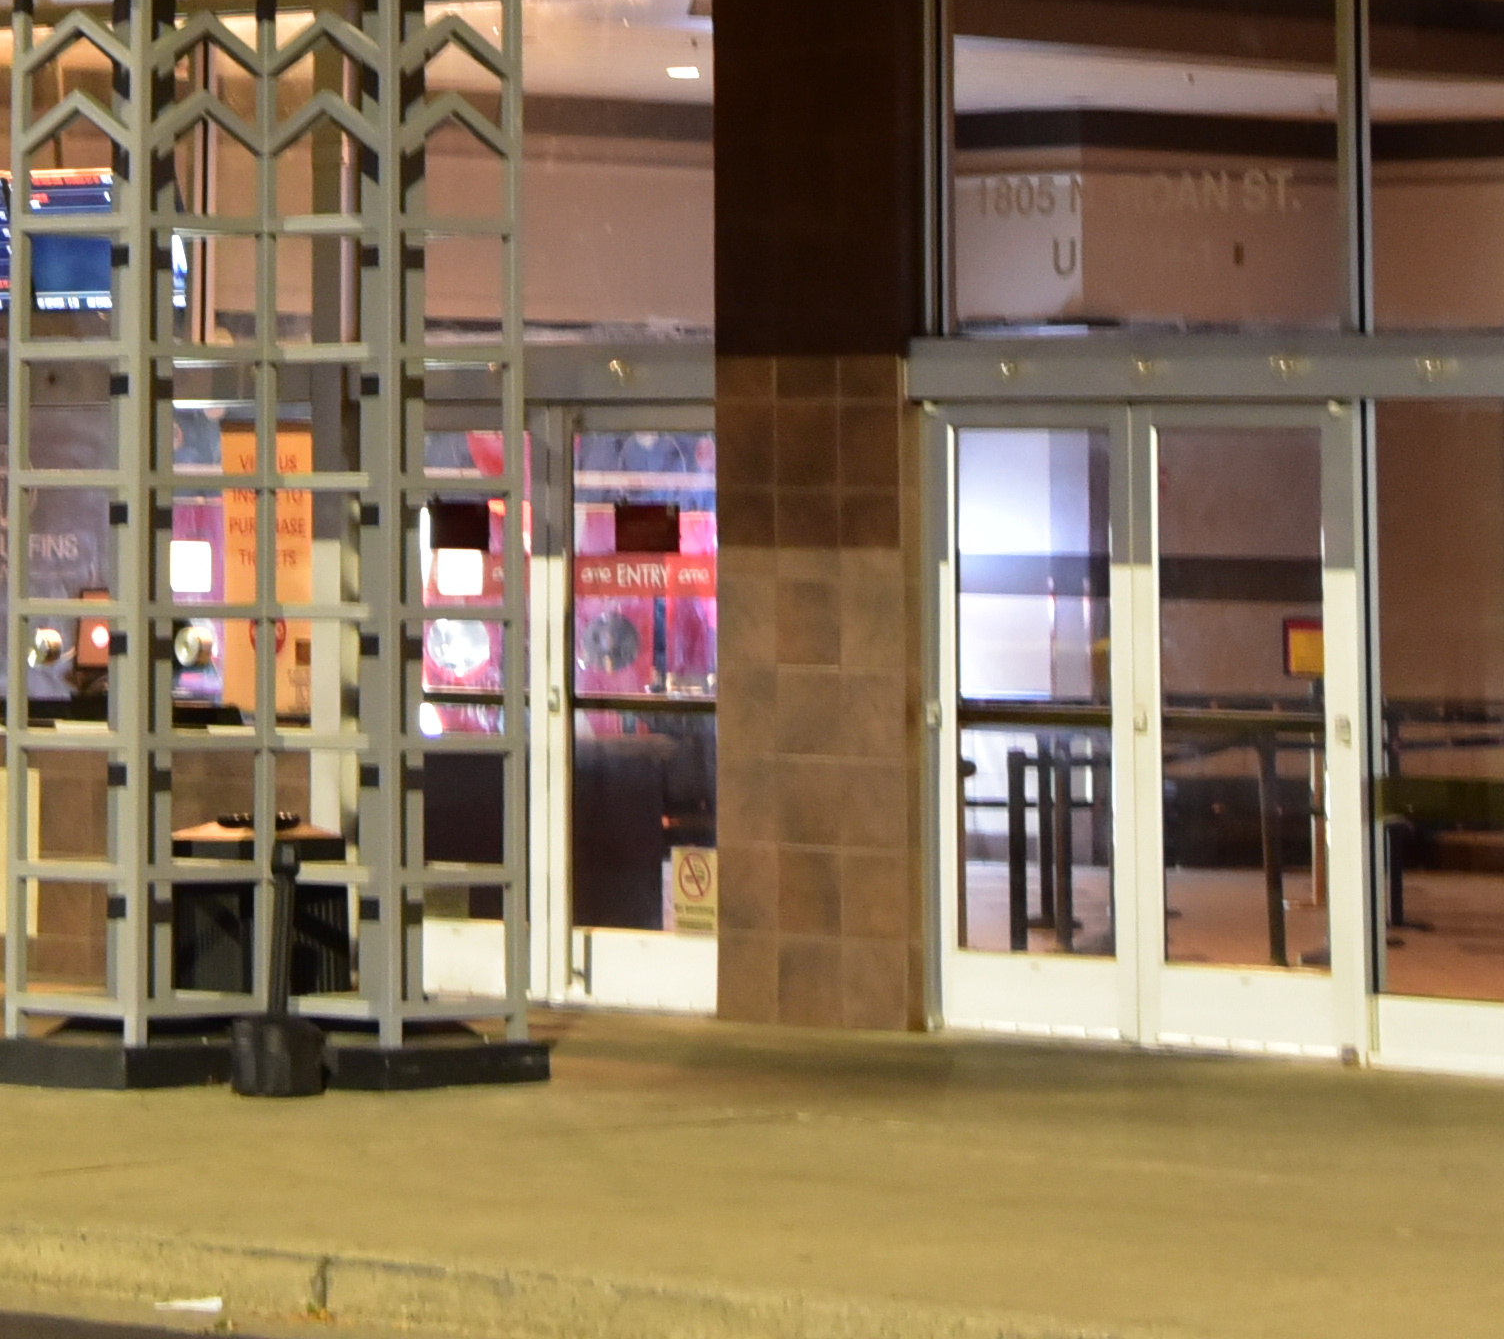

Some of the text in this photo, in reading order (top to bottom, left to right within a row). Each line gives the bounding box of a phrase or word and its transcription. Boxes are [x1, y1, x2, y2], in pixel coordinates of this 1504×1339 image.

[977, 174, 1056, 216] 1805
[278, 454, 298, 473] US
[228, 516, 307, 538] PURASE
[616, 562, 670, 589] ENTRY
